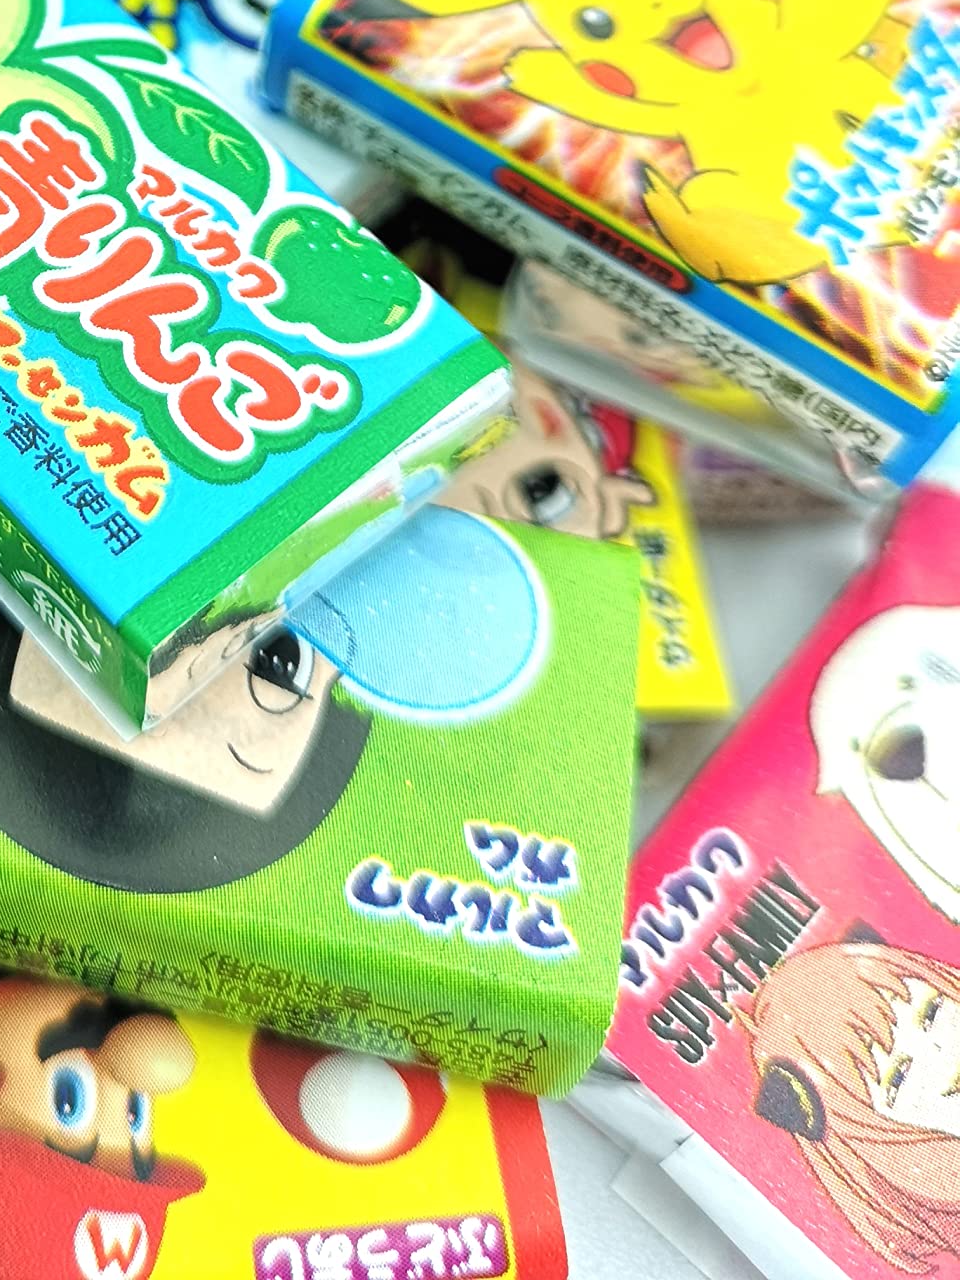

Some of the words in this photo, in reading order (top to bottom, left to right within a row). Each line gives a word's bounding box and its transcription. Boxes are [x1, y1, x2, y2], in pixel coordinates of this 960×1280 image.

[134, 163, 278, 299] マルカワ
[345, 860, 576, 957] マルカワ
